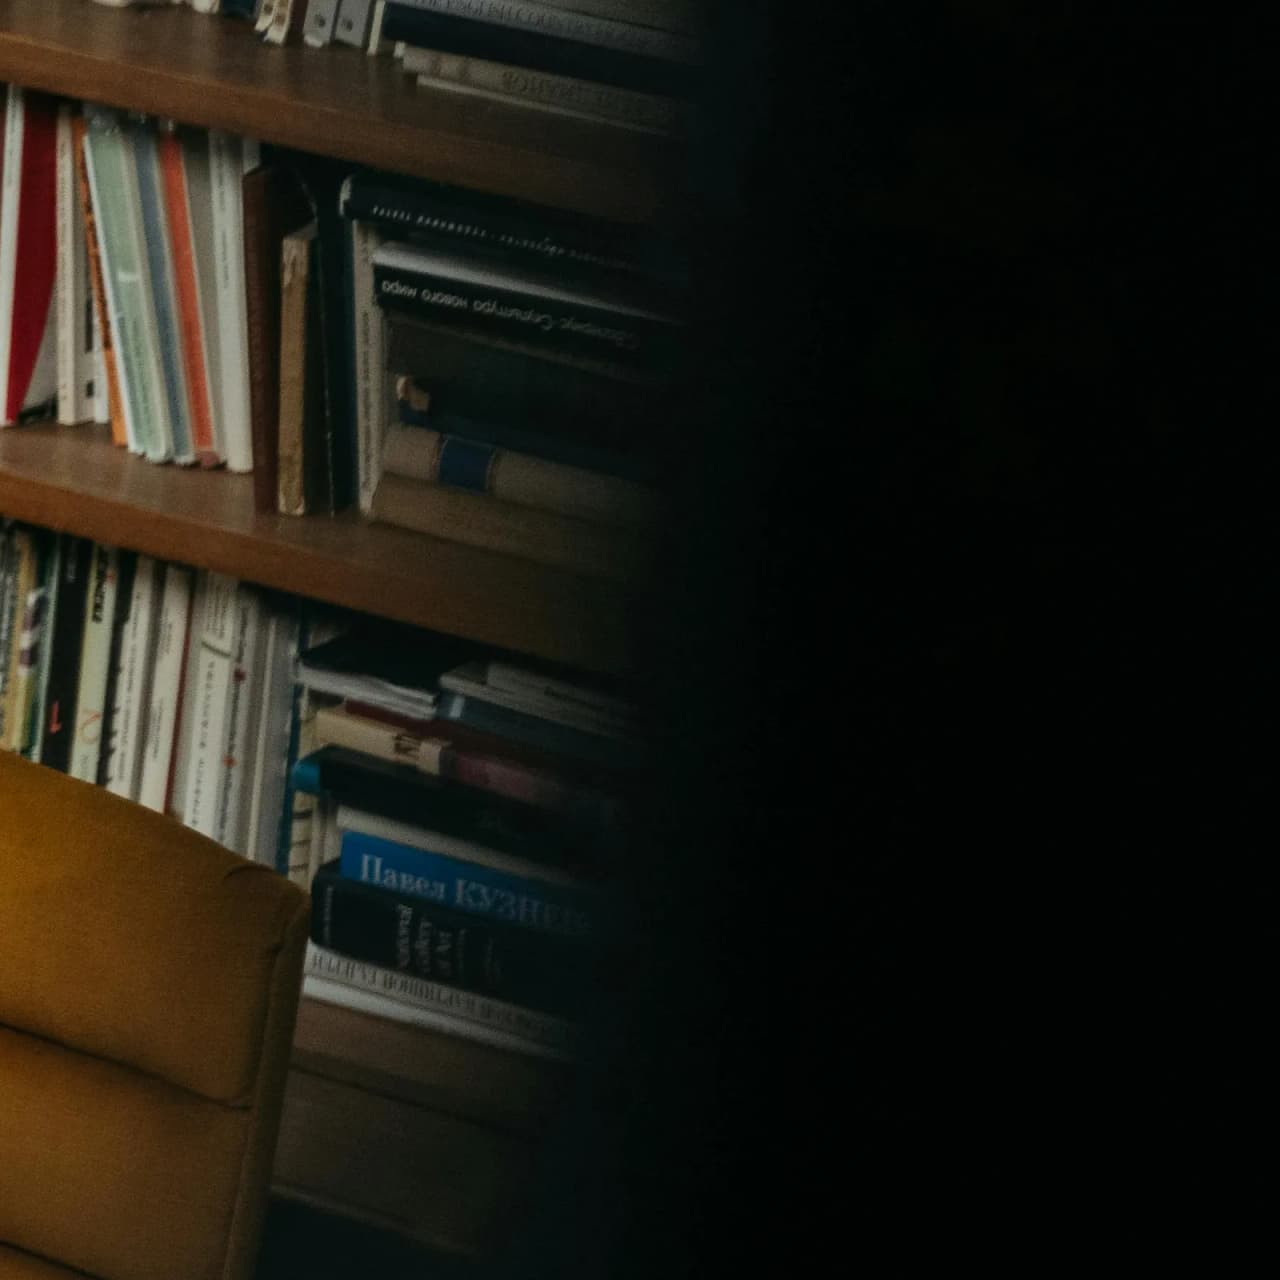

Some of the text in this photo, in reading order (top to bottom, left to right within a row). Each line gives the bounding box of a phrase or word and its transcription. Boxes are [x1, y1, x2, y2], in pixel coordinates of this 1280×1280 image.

[381, 279, 417, 299] мира
[421, 289, 469, 310] нового
[359, 852, 447, 902] Павел
